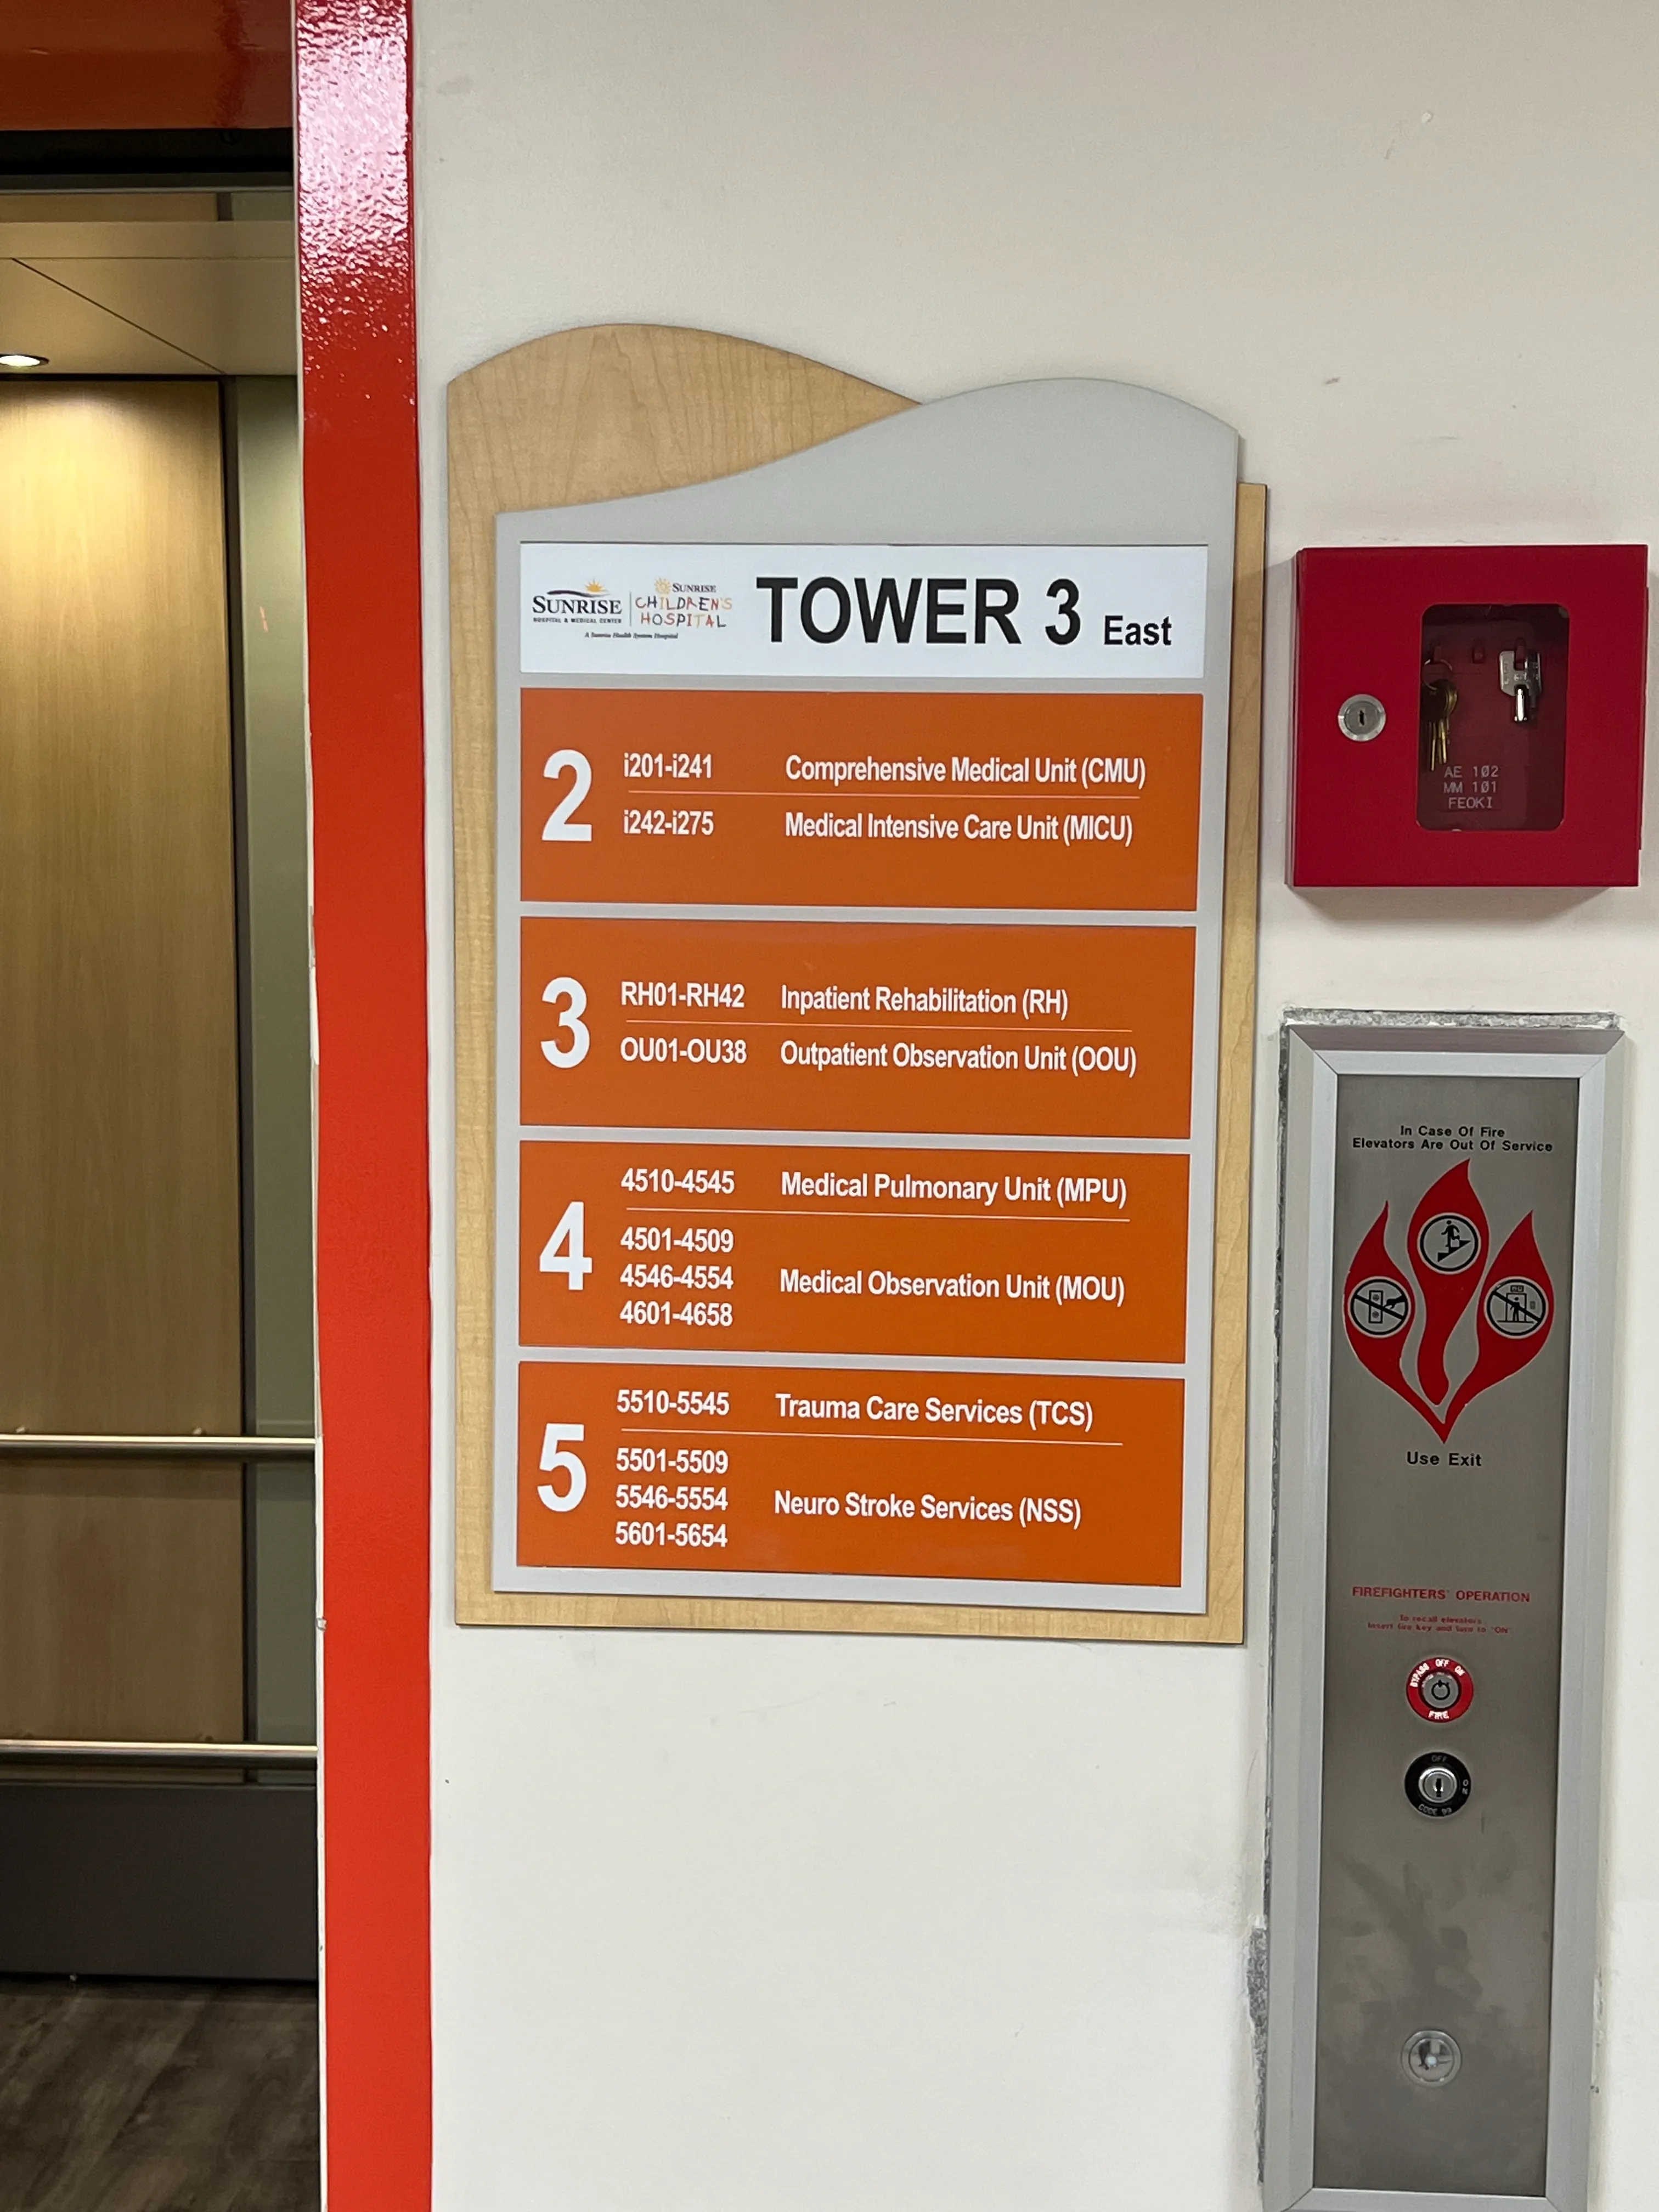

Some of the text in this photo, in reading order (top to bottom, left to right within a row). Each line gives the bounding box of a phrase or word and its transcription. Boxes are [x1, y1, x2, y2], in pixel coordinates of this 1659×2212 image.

[635, 595, 732, 611] CHILDREN'S
[757, 577, 1171, 645] TOWER 3 East
[641, 612, 726, 628] HOSPITAL
[624, 753, 711, 778] i201-i241
[786, 755, 1145, 789] Comprehensive Medical Unit (CMU)
[1444, 765, 1498, 777] AE 102
[542, 749, 591, 841] 2
[1443, 781, 1496, 793] MM 101
[624, 810, 713, 835] i242-i275
[786, 812, 1132, 847] Medical Intensive Care Unit (MICU)
[622, 981, 744, 1007] RH01-RH42
[781, 985, 1068, 1020] Inpatient Rehabilitation (RH)
[541, 977, 590, 1068] 3
[621, 1037, 747, 1063] OU01-OU38
[781, 1041, 1136, 1077] Outpatient Observation Unit (OOU)
[1401, 1125, 1505, 1137] In Case Of Fire
[1353, 1137, 1553, 1152] Elevators Are Out Of Service
[621, 1168, 734, 1193] 4510-4545
[781, 1172, 1126, 1209] Medical Pulmonary Unit (MPU)
[539, 1201, 592, 1290] 4
[620, 1227, 733, 1252] 4501-4509
[620, 1264, 733, 1289] 4546-4554
[781, 1269, 1124, 1307] Medical Observation Unit (MOU)
[620, 1301, 732, 1326] 4601-4658
[617, 1390, 729, 1415] 5510-5545
[776, 1393, 1092, 1432] Trauma Care Services (TCS)
[538, 1423, 586, 1512] 5
[617, 1448, 728, 1474] 5501-5509
[1407, 1452, 1481, 1466] Use Exit
[616, 1485, 728, 1510] 5546-5554
[775, 1491, 1080, 1529] Neuro Stroke Services (NSS)
[616, 1521, 727, 1547] 5601-5654
[1456, 1590, 1530, 1602] OPERATION
[1435, 1658, 1450, 1667] OFF
[1428, 1710, 1449, 1719] FIRE
